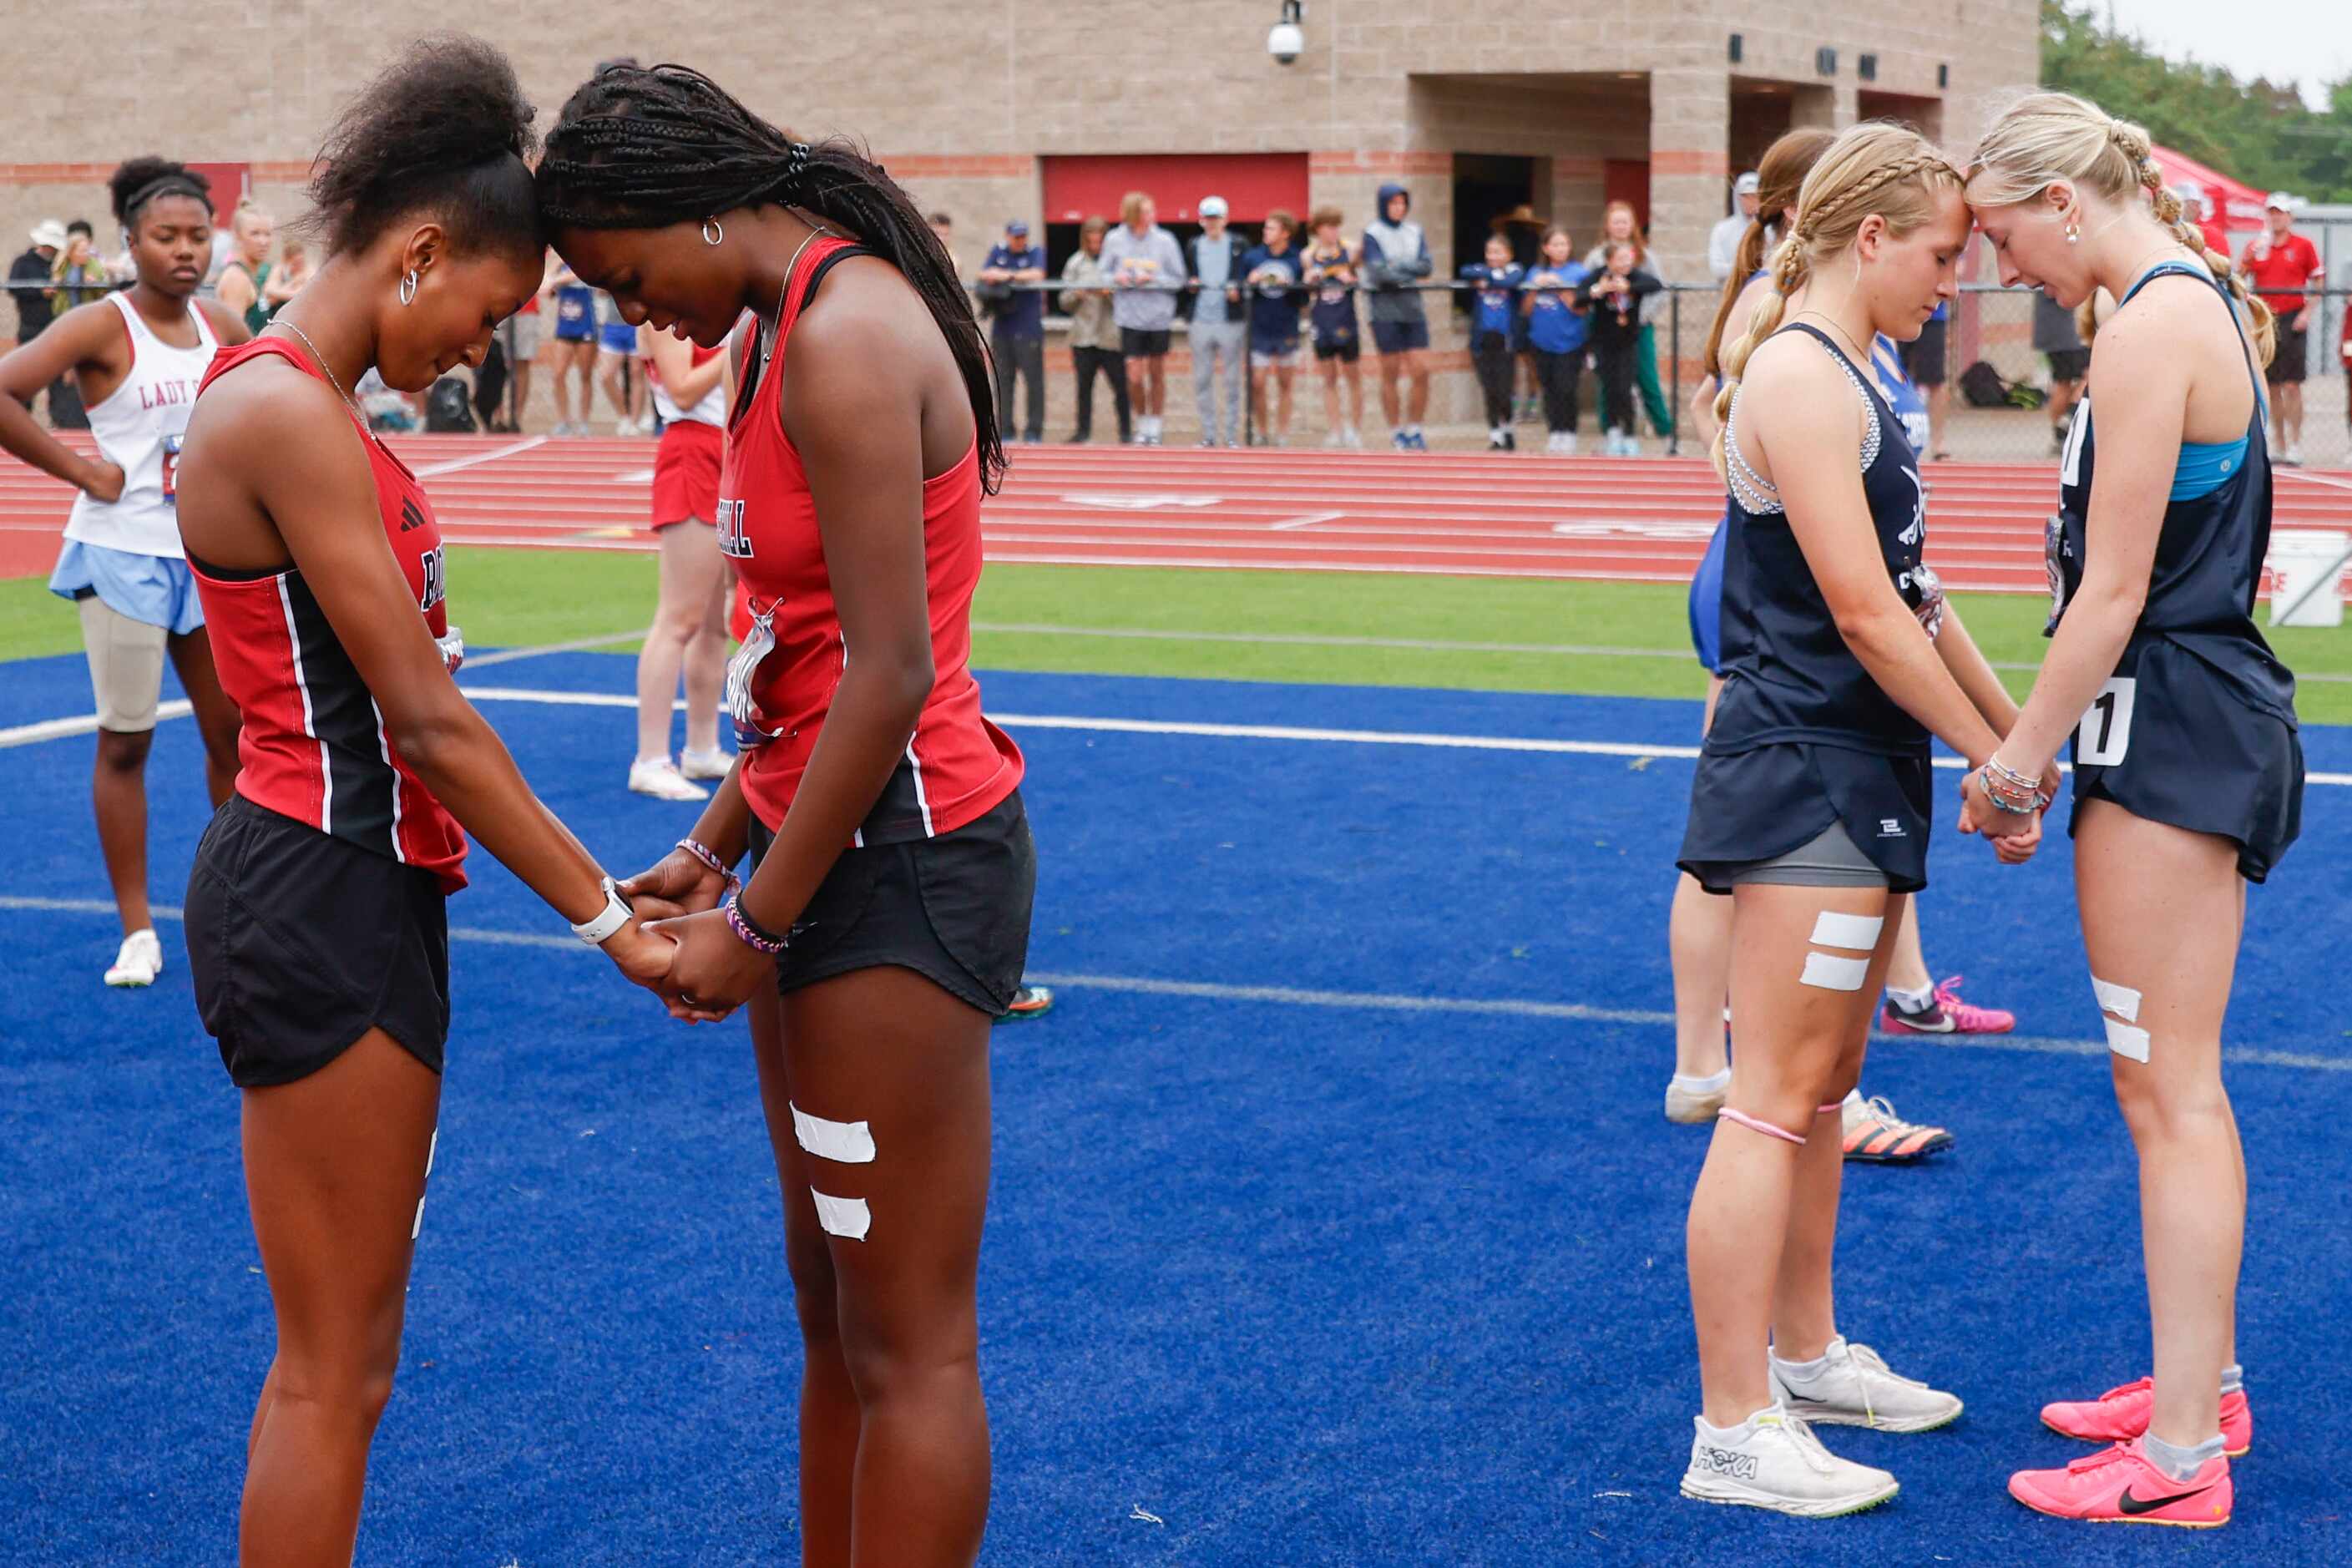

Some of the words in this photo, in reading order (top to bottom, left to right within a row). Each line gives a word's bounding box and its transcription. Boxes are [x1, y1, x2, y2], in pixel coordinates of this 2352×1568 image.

[139, 379, 187, 411] LADY
[2095, 691, 2115, 754] 1
[1693, 1446, 1758, 1480] HOKA
